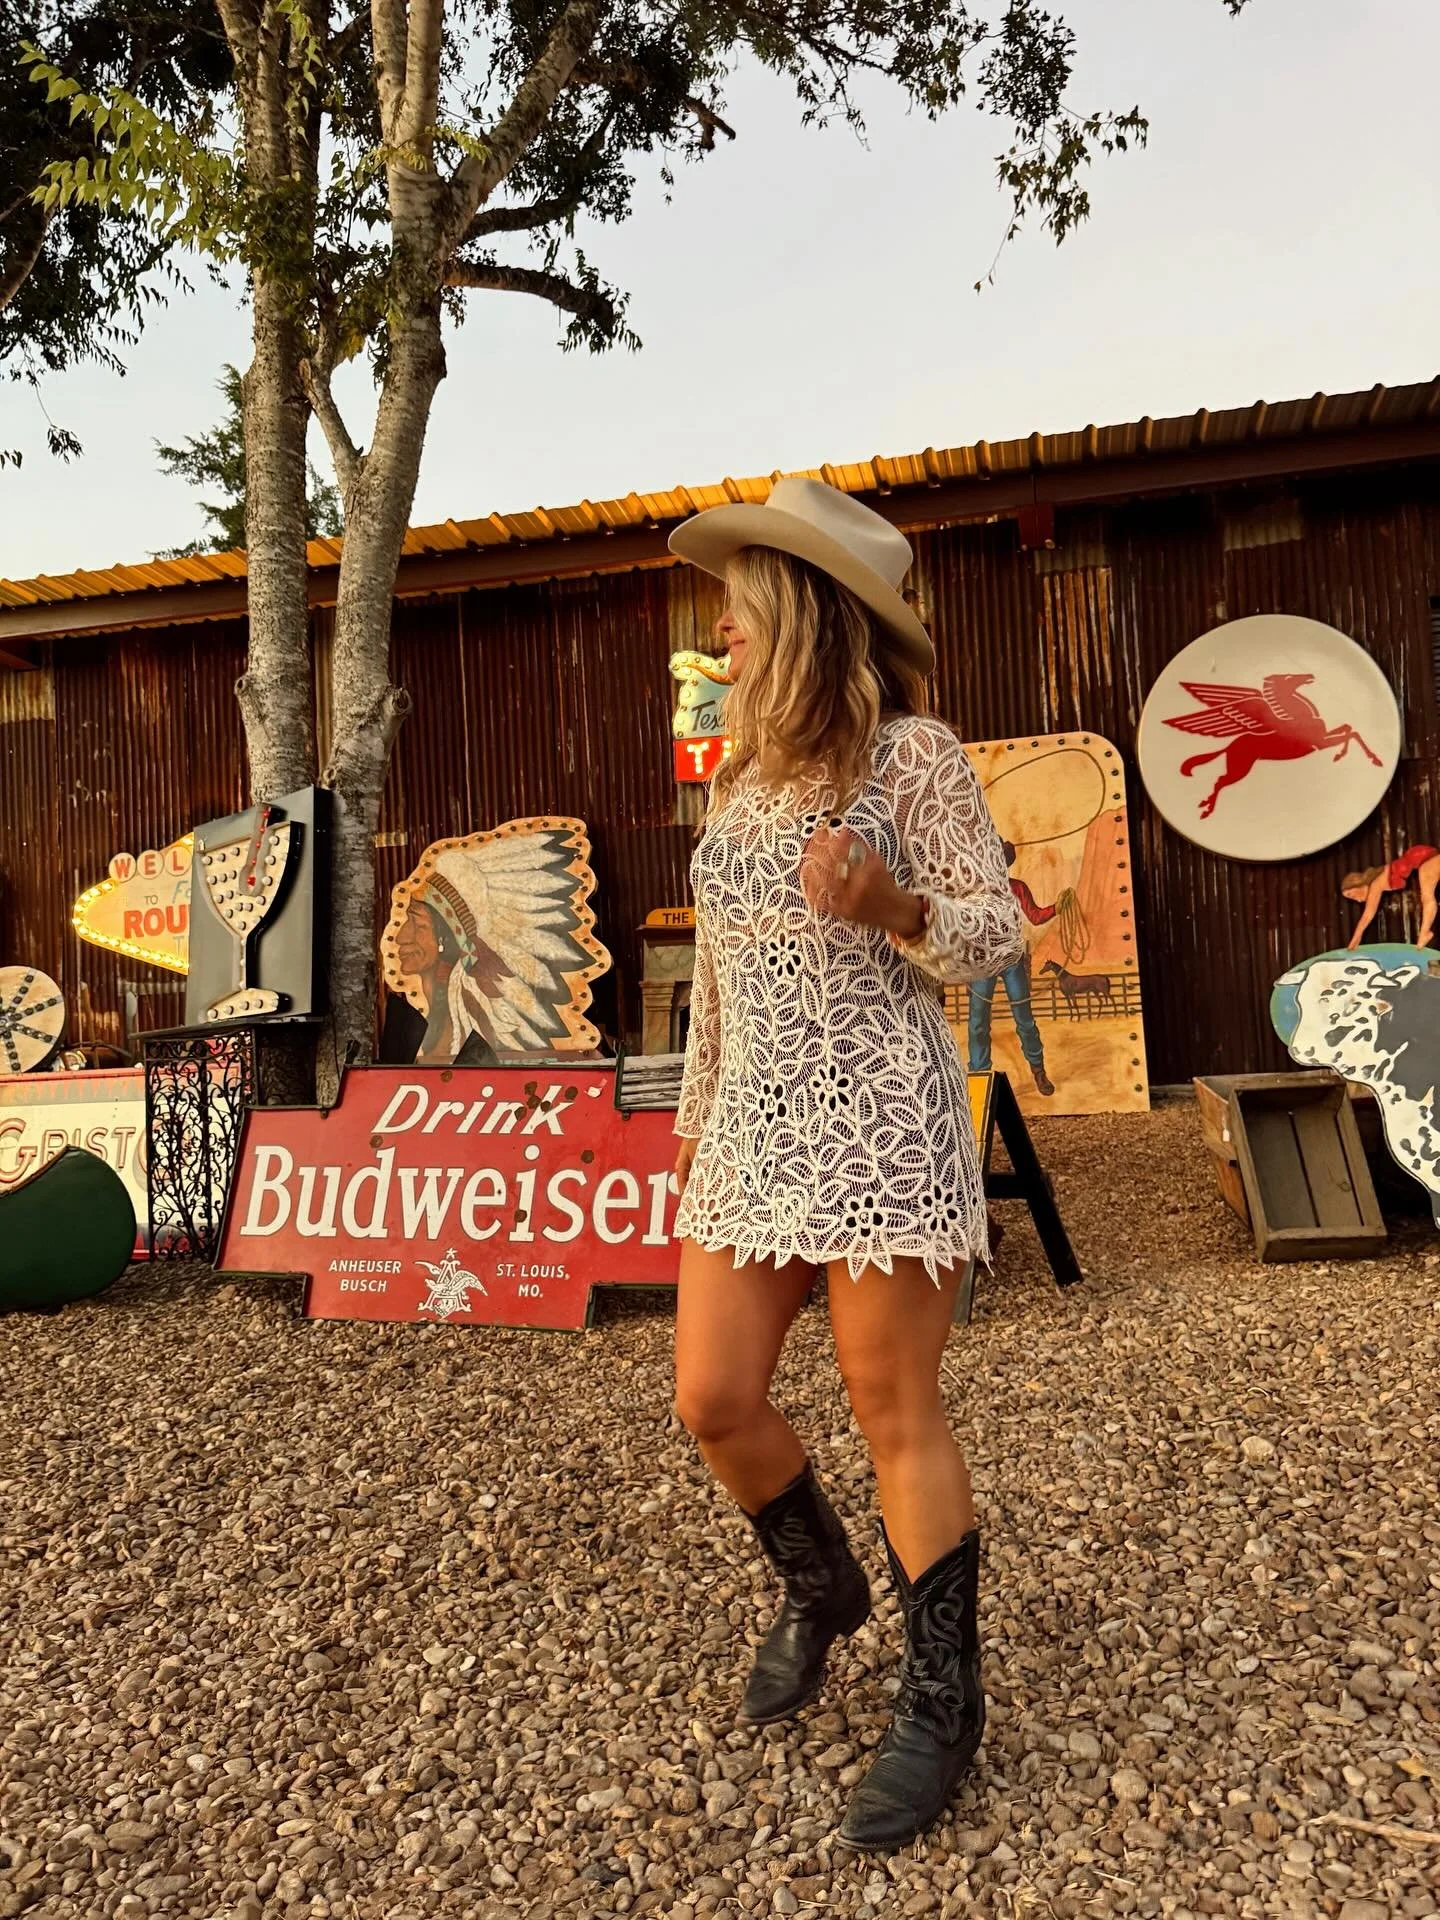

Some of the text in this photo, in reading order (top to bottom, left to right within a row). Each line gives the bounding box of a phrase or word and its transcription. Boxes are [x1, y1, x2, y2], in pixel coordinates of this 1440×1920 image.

[144, 894, 159, 905] TO
[123, 904, 191, 939] ROU
[662, 911, 689, 924] THE
[371, 1084, 573, 1136] Drink
[240, 1145, 680, 1245] Budweiser
[329, 1260, 402, 1274] ANHEUSER
[496, 1263, 570, 1280] ST. LOUIS,
[340, 1279, 387, 1292] BUSCH
[518, 1284, 544, 1298] MO.
